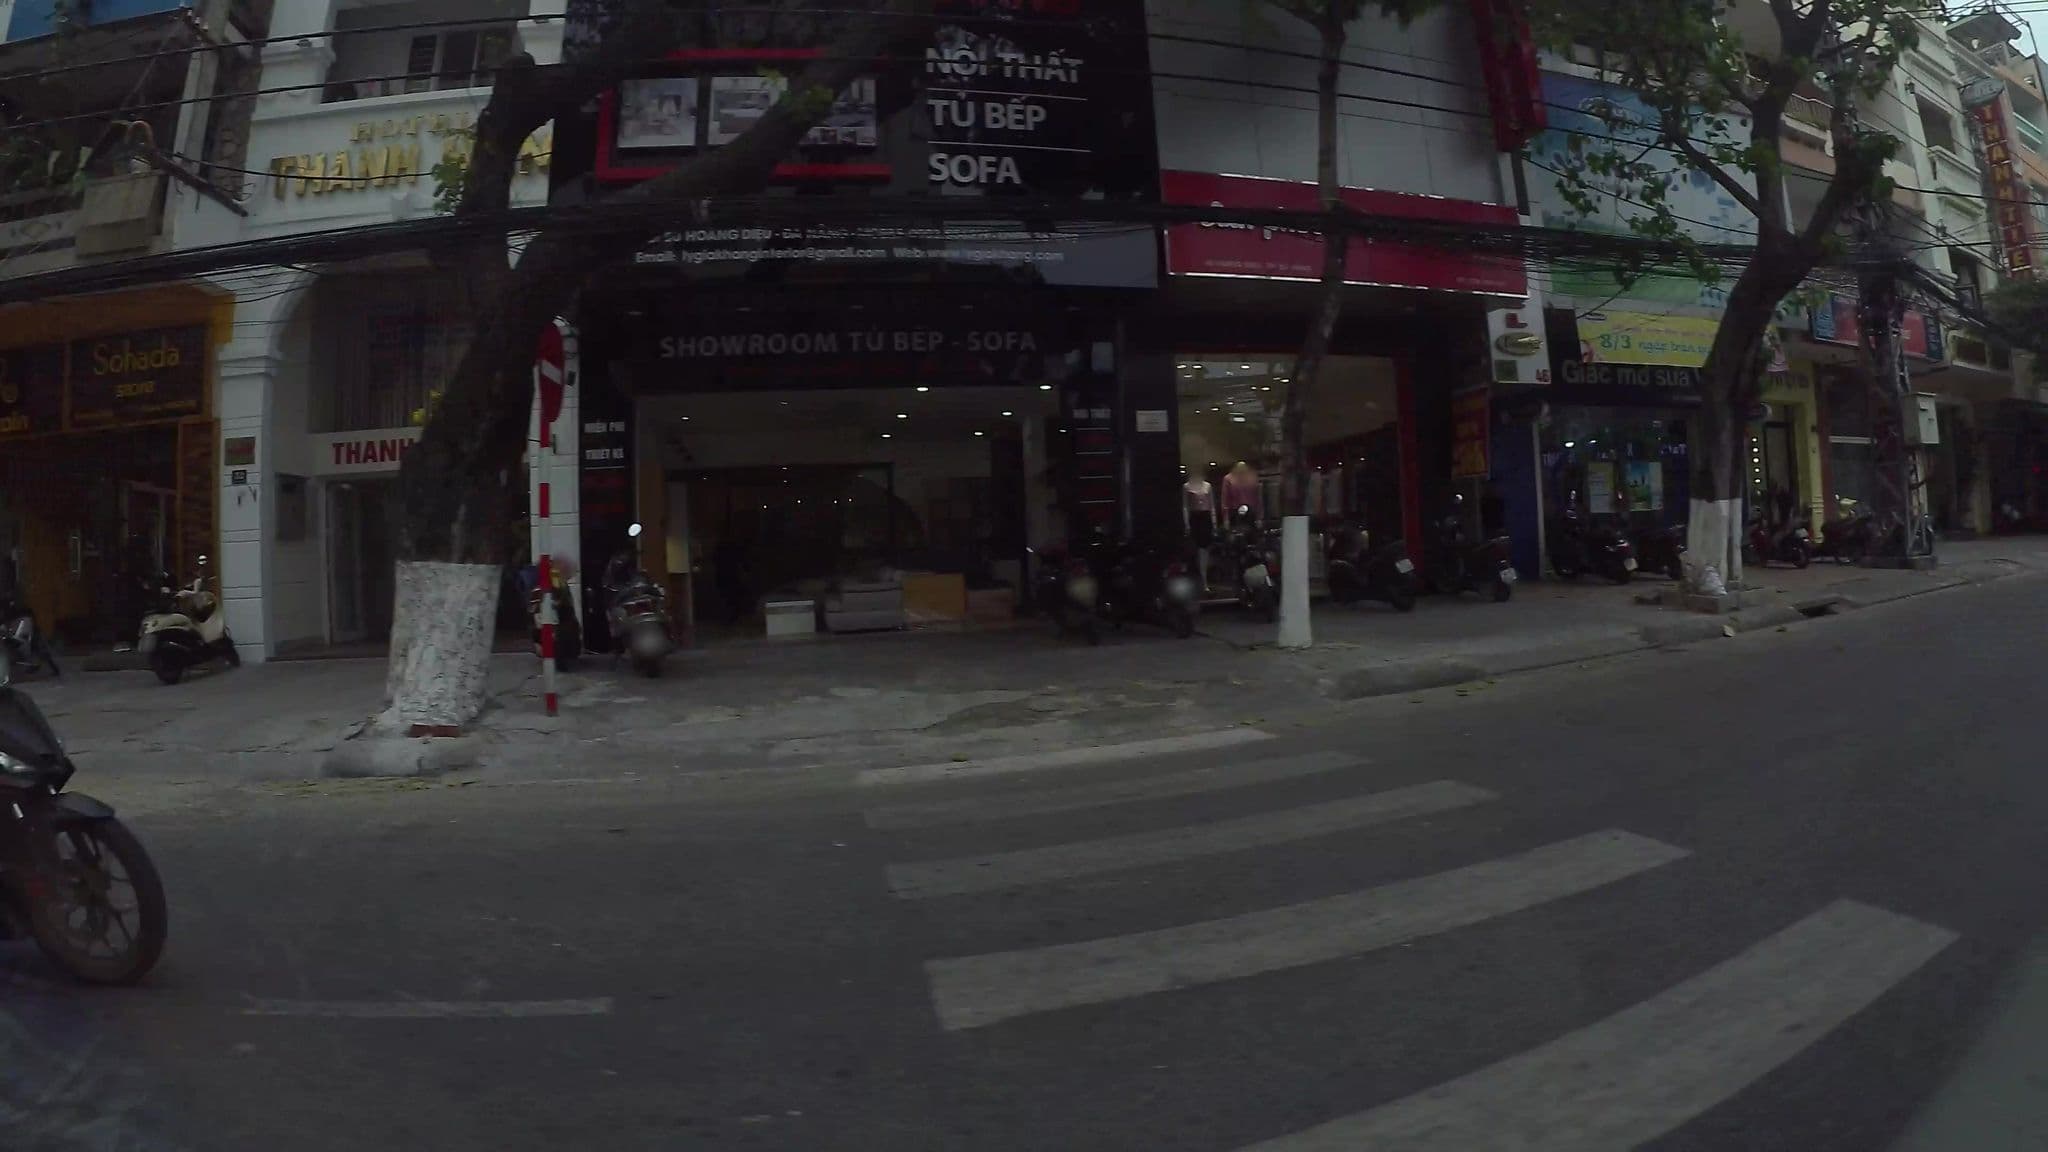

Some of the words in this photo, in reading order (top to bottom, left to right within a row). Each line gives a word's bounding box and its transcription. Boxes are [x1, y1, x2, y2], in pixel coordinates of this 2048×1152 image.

[926, 45, 986, 82] NỘI
[995, 48, 1084, 84] THẤT
[927, 90, 976, 128] TỦ
[984, 96, 1047, 131] BẾP
[271, 143, 422, 200] THANH
[928, 152, 1022, 184] SOFA
[93, 335, 180, 376] Sohada
[659, 331, 839, 358] SHOWROOM
[849, 323, 883, 352] TỦ
[894, 325, 943, 352] BẾP
[967, 331, 1037, 352] SOFA
[1599, 333, 1632, 351] 8/3
